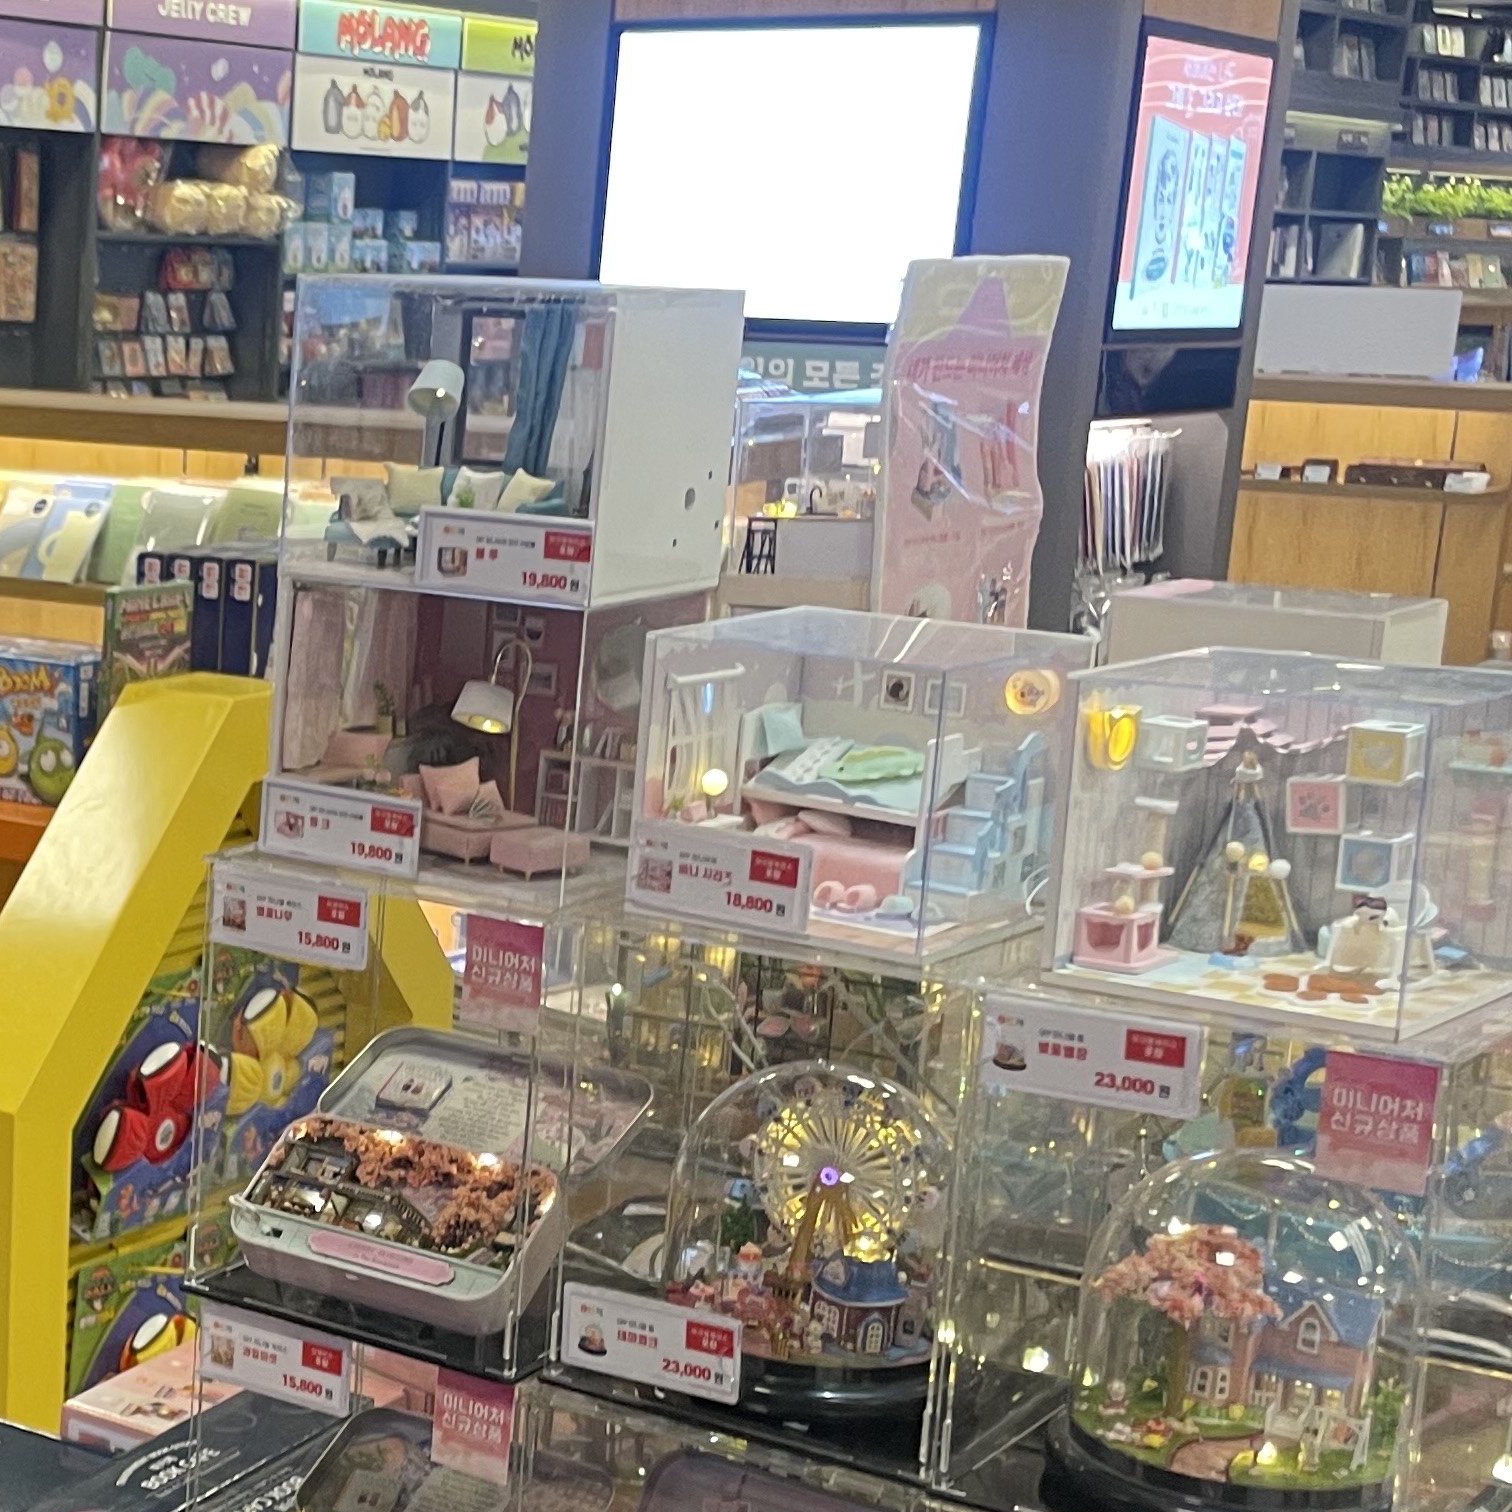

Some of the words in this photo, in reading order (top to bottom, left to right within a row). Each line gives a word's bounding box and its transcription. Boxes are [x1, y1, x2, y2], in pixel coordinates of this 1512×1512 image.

[205, 2, 252, 26] CREW
[337, 9, 430, 63] MOLANG
[803, 359, 860, 389] 모든
[521, 571, 568, 591] 19,800
[350, 841, 392, 861] 19,800
[726, 890, 773, 914] 18,800
[297, 930, 340, 952] 15,800
[1094, 1071, 1155, 1096] 23,000
[662, 1357, 712, 1382] 23,000
[282, 1373, 323, 1397] 15,800
